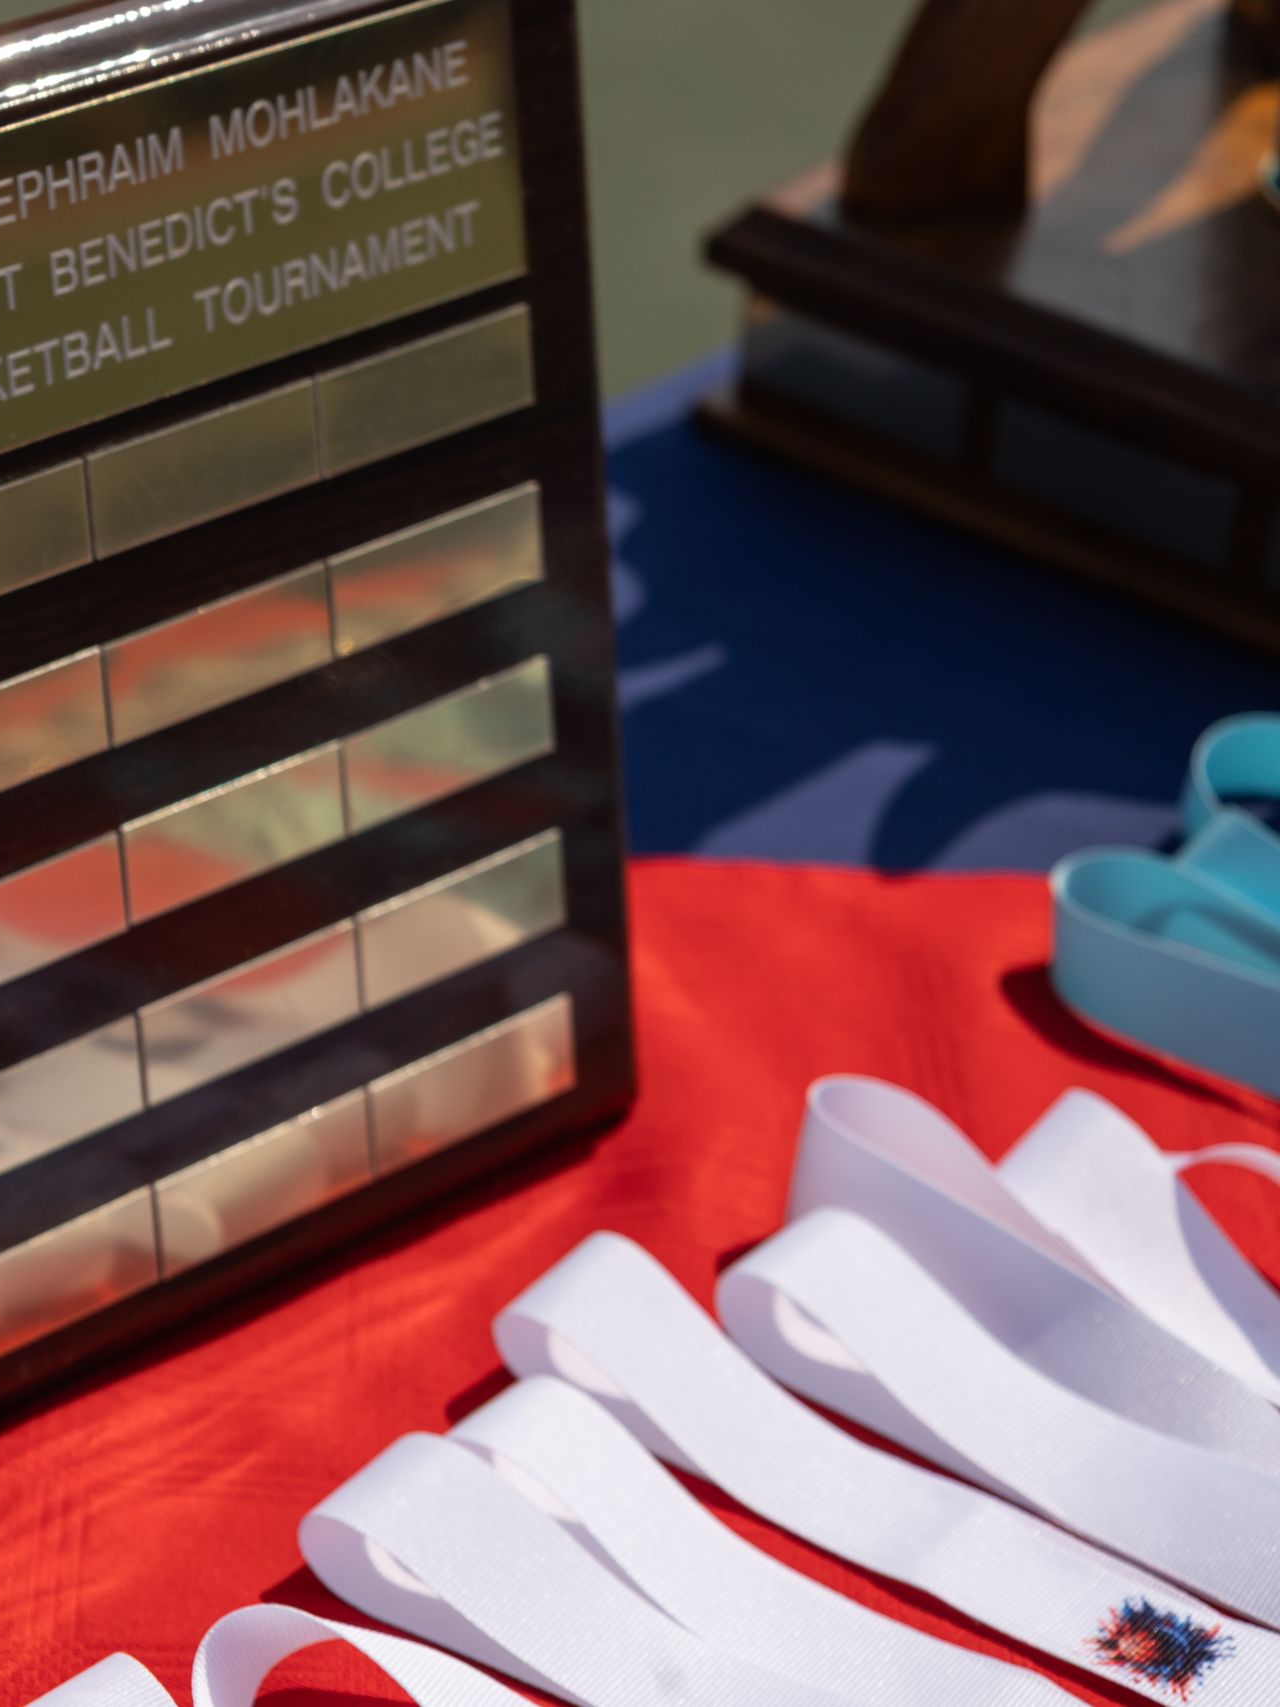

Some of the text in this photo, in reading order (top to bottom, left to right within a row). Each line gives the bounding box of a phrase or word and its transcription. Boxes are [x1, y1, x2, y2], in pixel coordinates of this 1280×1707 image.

[210, 39, 470, 160] MOHLAKANE
[50, 177, 300, 296] BENEDICT'S
[321, 111, 505, 209] COLLEGE
[194, 201, 480, 332] TOURNAMENT
